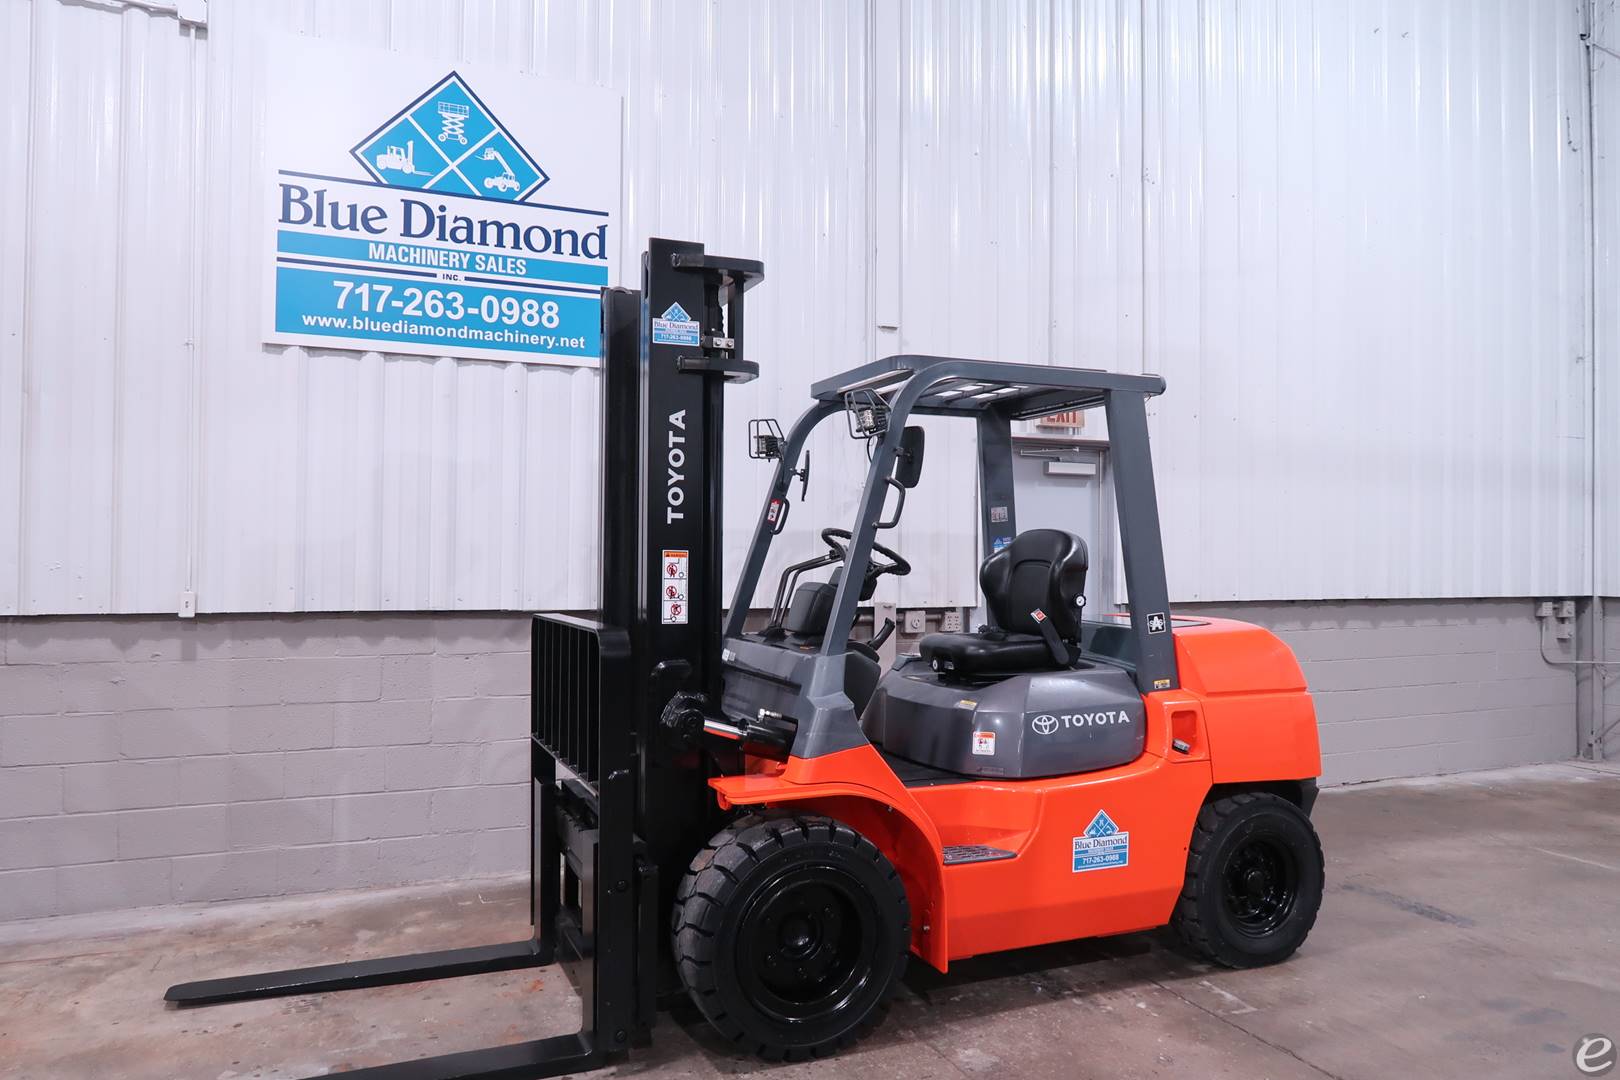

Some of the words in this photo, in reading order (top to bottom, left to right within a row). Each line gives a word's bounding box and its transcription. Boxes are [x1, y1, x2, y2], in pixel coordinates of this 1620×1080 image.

[278, 183, 388, 234] Blue
[400, 198, 608, 260] Diamond
[368, 242, 470, 271] MACHINERY
[475, 255, 527, 275] SALES
[442, 273, 462, 282] INC.
[333, 280, 560, 329] 717-263-0988
[302, 313, 585, 349] www.bluediamondmachinery.net
[667, 409, 686, 525] TOYOTA
[1061, 710, 1130, 728] TOYOTA
[1075, 840, 1092, 850] Blue
[1093, 835, 1128, 848] Diamond
